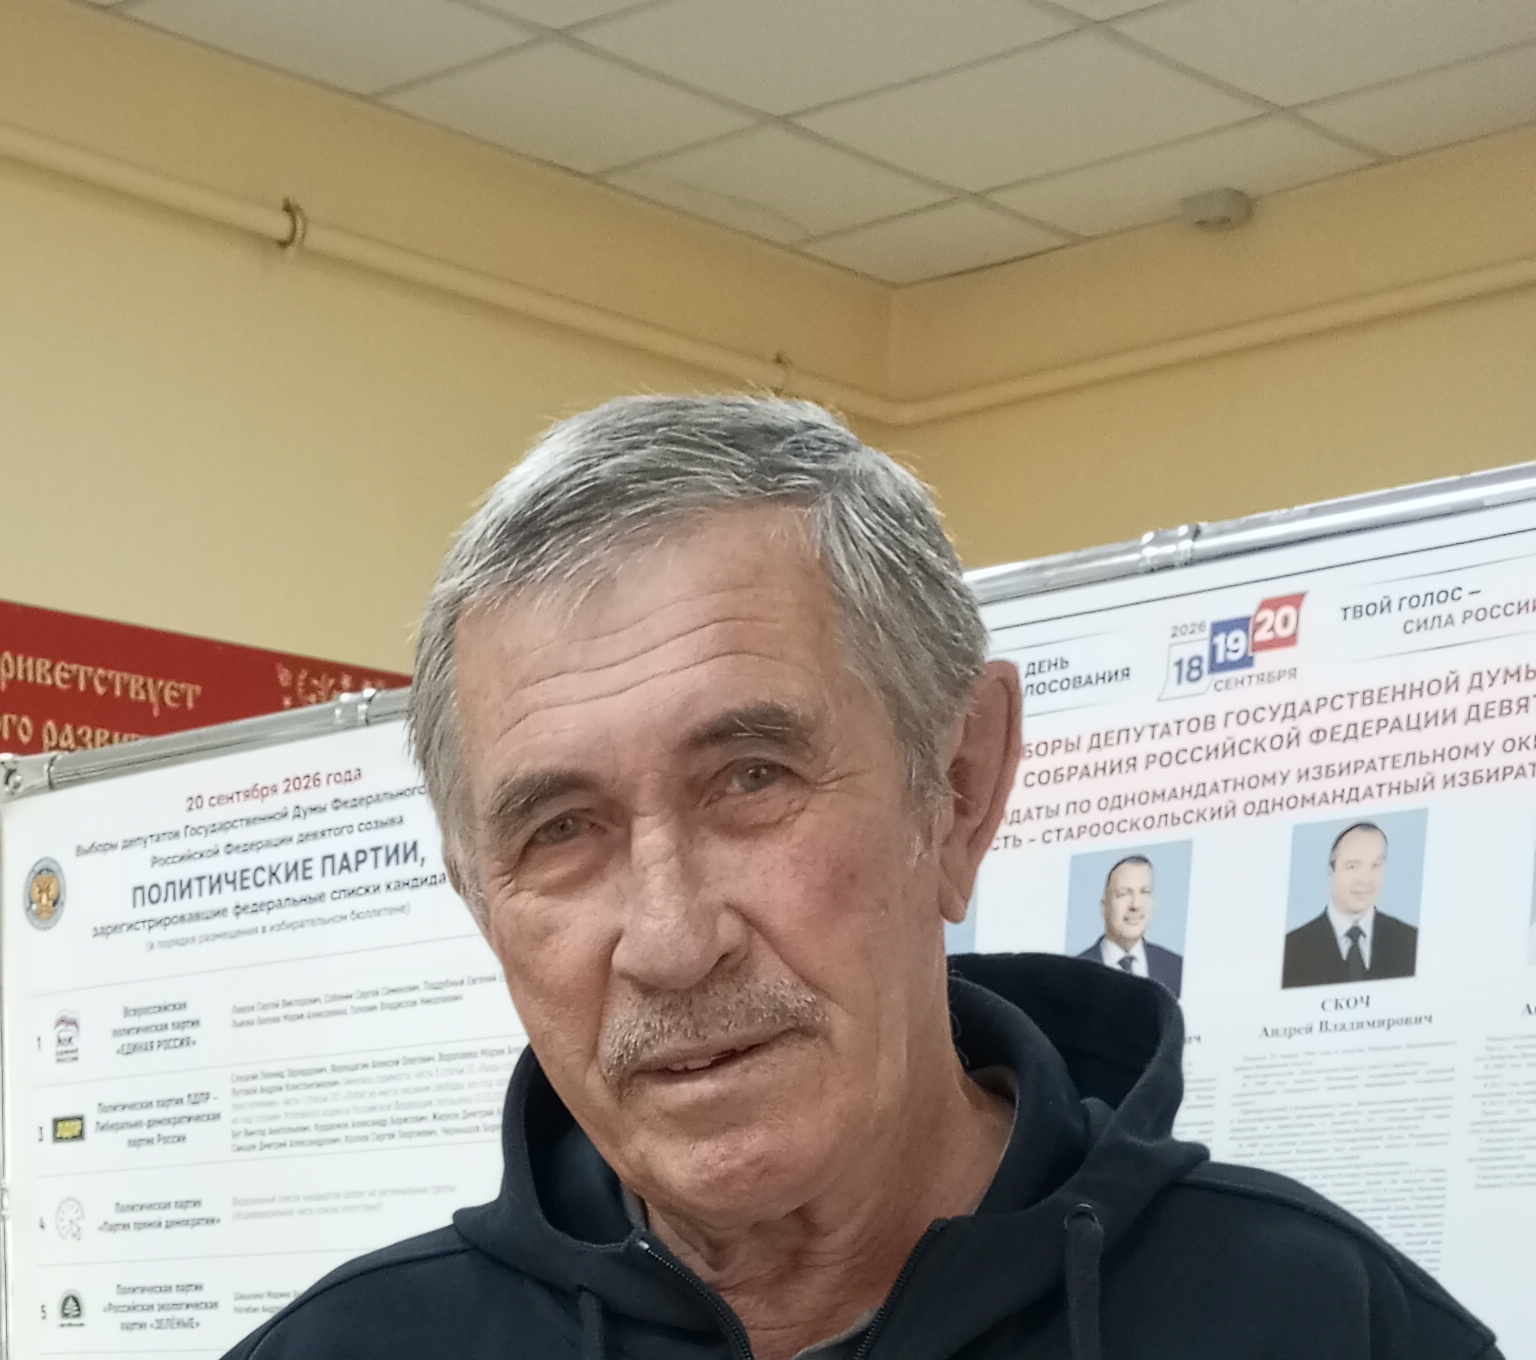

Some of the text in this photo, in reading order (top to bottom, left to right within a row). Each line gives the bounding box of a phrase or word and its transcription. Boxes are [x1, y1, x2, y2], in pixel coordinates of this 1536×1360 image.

[1340, 595, 1392, 622] ТВОЙ
[1396, 585, 1463, 612] ГОЛОС
[1170, 619, 1207, 639] 2026
[1252, 604, 1299, 643] 20
[1402, 613, 1456, 635] СИЛА
[1213, 628, 1248, 664] 19
[1024, 656, 1069, 679] ДЕНЬ
[1172, 654, 1204, 687] 18
[1213, 666, 1298, 693] СЕНТЯБРЯ
[1086, 713, 1216, 754] ДЕПУТАТОВ
[1223, 669, 1460, 730] ГОСУДАРСТВЕННОЙ
[1023, 693, 1536, 788] СОБРАНИЯ РОССИЙСКОЙ ФЕДЕРАЦИИ ДЕВЯ
[186, 767, 363, 813] 20 сентября 2026 года
[1064, 798, 1092, 817] ПО
[1097, 768, 1292, 813] ОДНОМАНДАТНОМУ
[1295, 738, 1496, 784] ИЗБИРАТЕЛЬНОМУ
[1502, 733, 1536, 755] ОК
[75, 784, 427, 858] Выборы депутатов Государственной Думы Федерального
[1041, 801, 1237, 845] СТАРООСКОЛЬСКИЙ
[1243, 771, 1436, 818] ОДНОМАНДАТНЫЙ
[150, 814, 405, 869] Российской Федерации девятого созыва
[132, 839, 427, 910] ПОЛИТИЧЕСКИЕ ПАРТИИ,
[92, 906, 229, 940] зарегистрировавшие
[232, 891, 327, 921] федеральные
[330, 883, 381, 902] списки
[269, 914, 348, 934] избирательном
[1320, 995, 1372, 1013] СКОЧ
[1259, 1012, 1434, 1040] Андрей Владимирович
